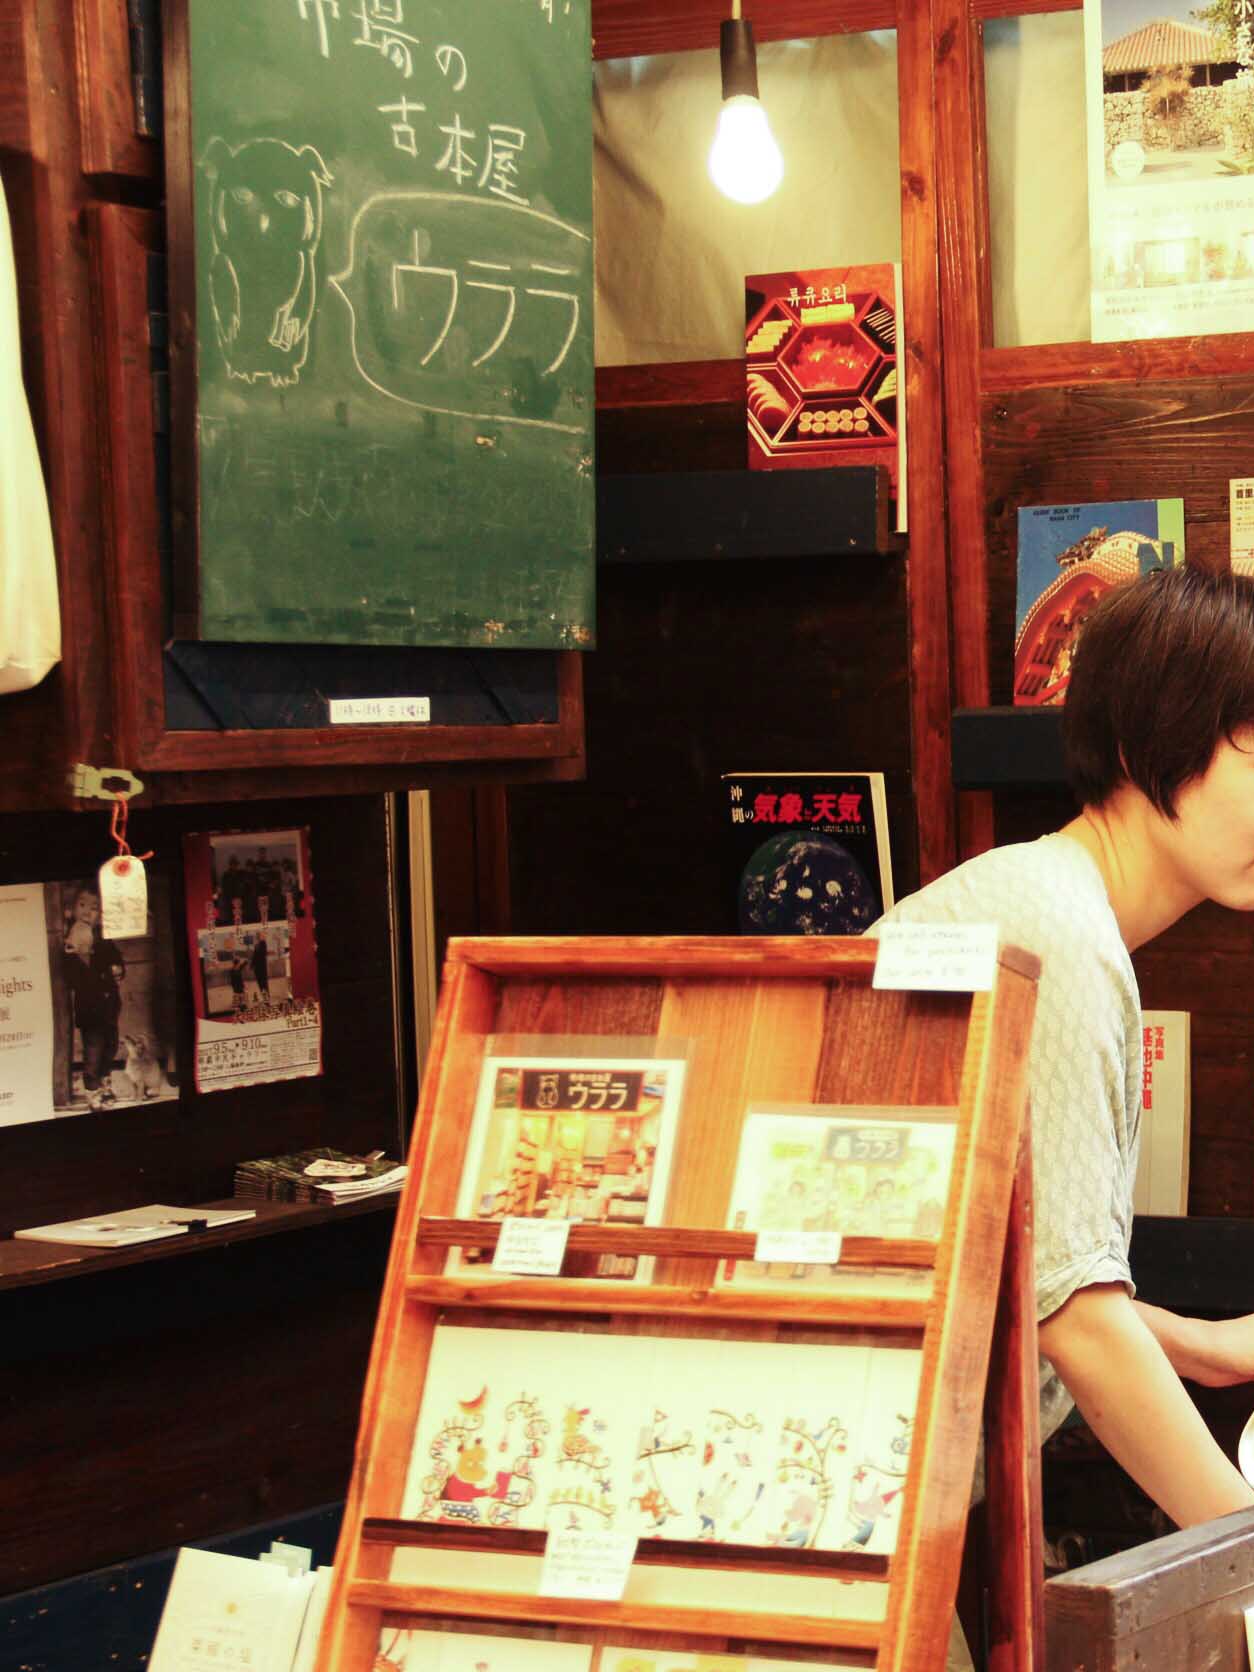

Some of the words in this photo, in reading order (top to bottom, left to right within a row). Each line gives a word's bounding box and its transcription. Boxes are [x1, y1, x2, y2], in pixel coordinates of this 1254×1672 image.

[378, 96, 530, 206] 古本屋
[394, 229, 580, 376] ウララ
[787, 284, 848, 308] 류큐요리
[567, 1082, 628, 1110] ウララ
